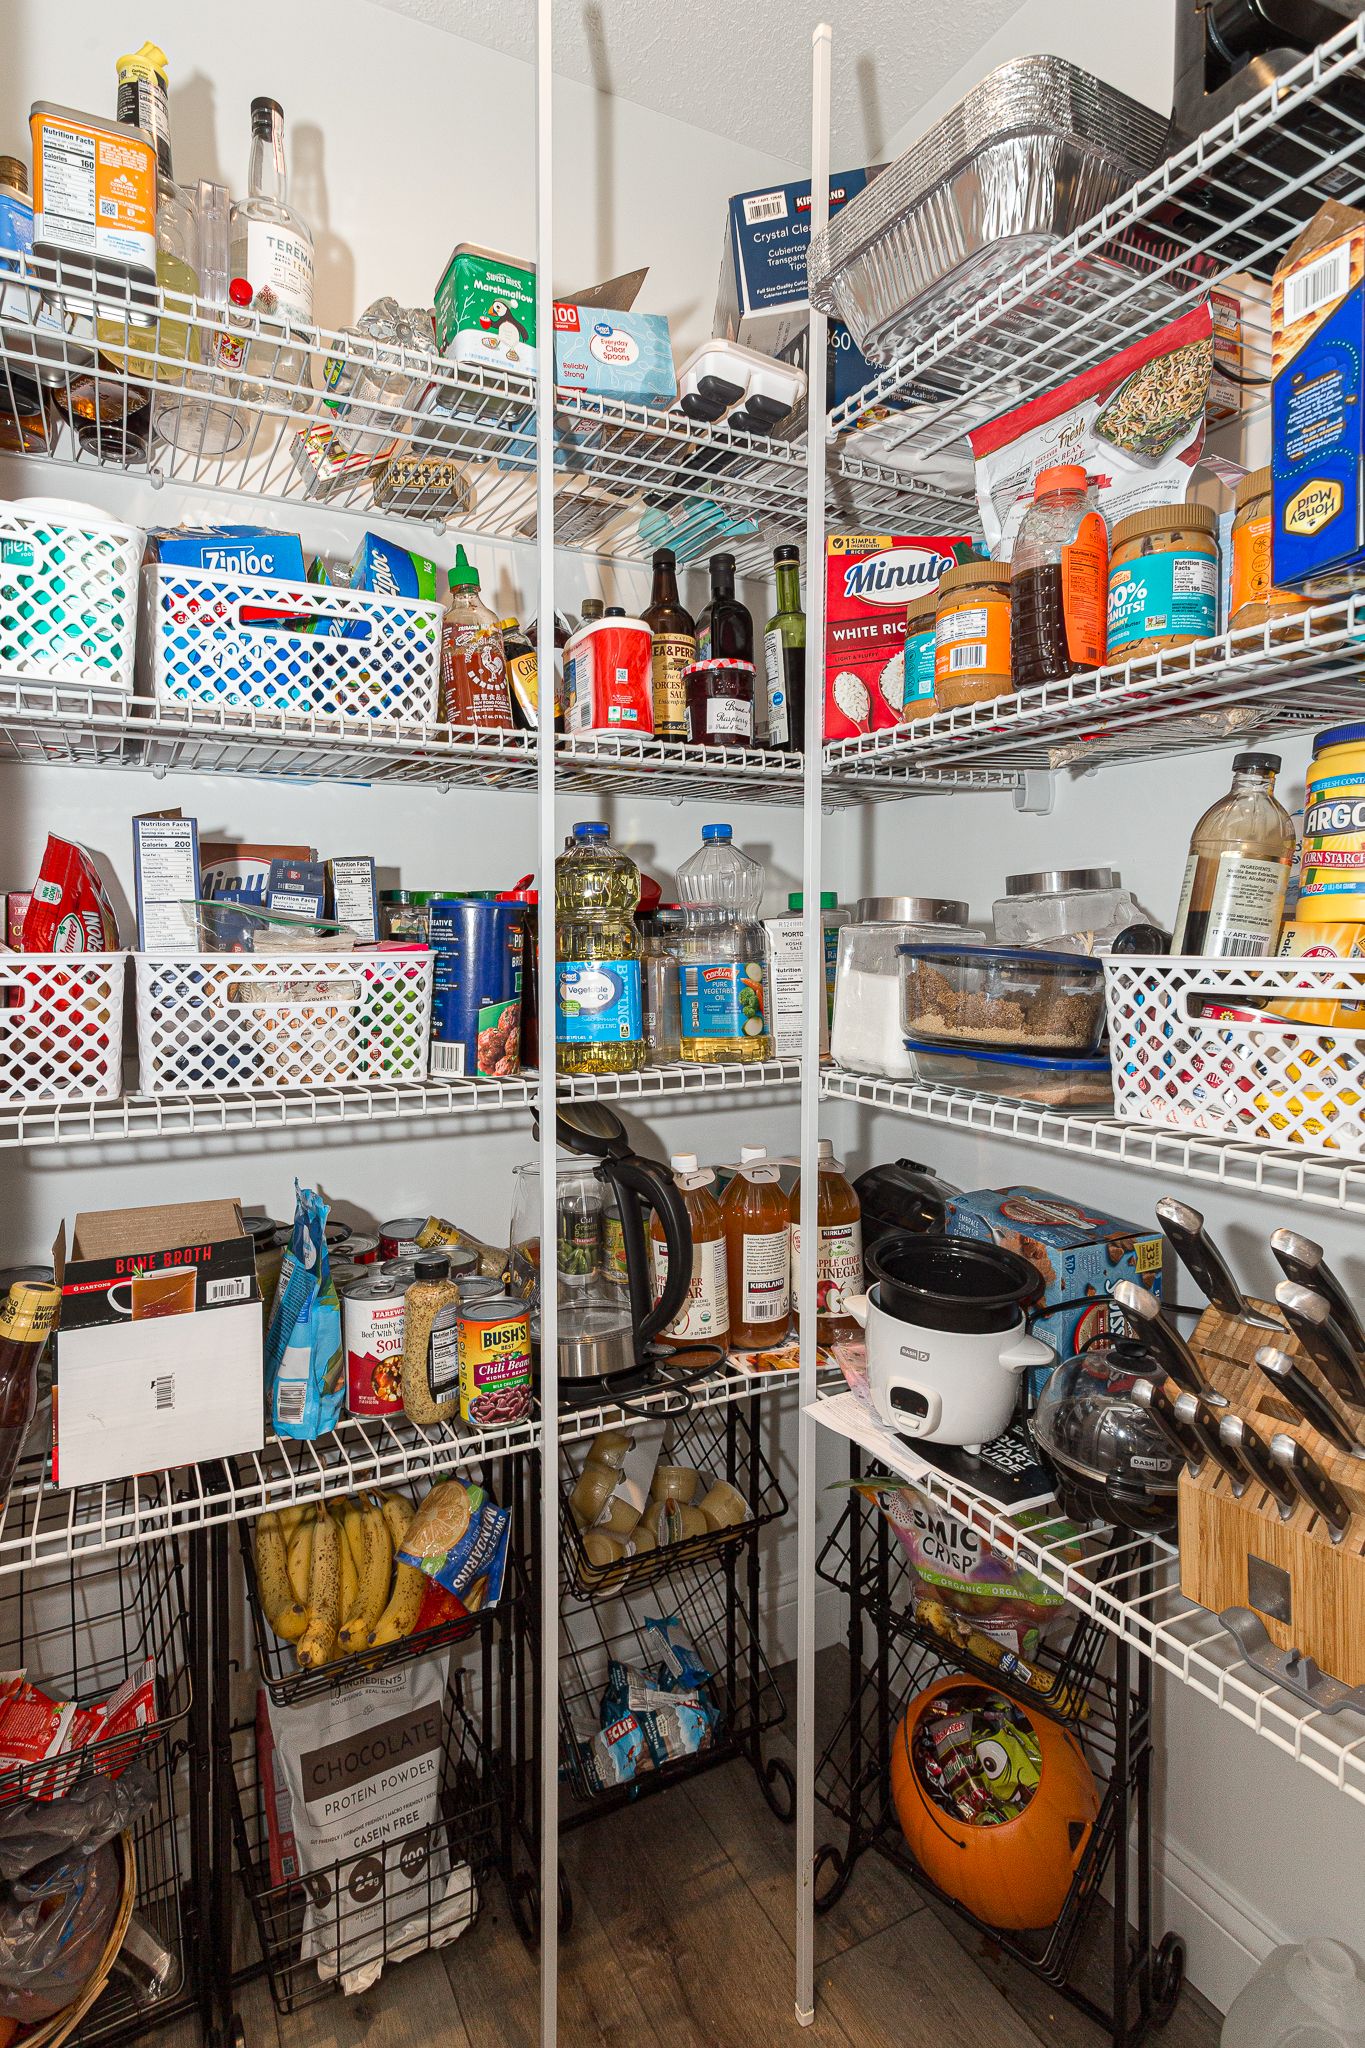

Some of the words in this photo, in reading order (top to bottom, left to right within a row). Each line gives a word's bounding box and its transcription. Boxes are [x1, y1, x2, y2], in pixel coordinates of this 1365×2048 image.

[43, 126, 74, 141] Nutrition
[75, 135, 95, 146] Facts
[43, 151, 68, 163] Calories
[80, 159, 95, 170] 160
[753, 226, 789, 244] Crystal
[791, 223, 812, 236] Clea
[768, 243, 807, 258] Cubiertos
[789, 261, 807, 271] Tipo
[473, 279, 534, 304] Marshmallow
[756, 286, 766, 294] Full
[766, 284, 776, 293] Size
[553, 307, 577, 323] 100
[600, 338, 629, 348] Everyday
[605, 344, 626, 354] Clear
[602, 351, 630, 362] Spoons
[562, 362, 589, 372] Reliably
[564, 371, 585, 380] Strong
[1057, 417, 1086, 449] Fresh
[1033, 456, 1060, 478] GREEN
[1060, 443, 1083, 462] BEAN
[1295, 486, 1332, 512] Maid
[1289, 497, 1335, 526] Honey
[845, 538, 850, 547] 1
[204, 550, 275, 574] Ziploc
[423, 559, 435, 574] 145
[371, 549, 401, 596] Ziploc
[845, 553, 954, 597] Minute
[1107, 578, 1148, 614] 00%
[832, 625, 879, 641] WHITE
[882, 621, 907, 636] RIC
[517, 657, 538, 676] GRA
[716, 711, 749, 728] Raspberry
[1306, 802, 1365, 834] ARGO
[1304, 852, 1324, 864] CORN
[1232, 931, 1248, 939] ART.
[568, 985, 608, 995] Vegetable
[597, 993, 609, 1001] Oil
[958, 1214, 980, 1230] EMBRACE
[115, 1255, 157, 1275] BONE
[163, 1245, 213, 1267] BROTH
[841, 1254, 860, 1267] CIDER
[1145, 1244, 1155, 1267] 33%
[817, 1264, 861, 1279] VINEGAR
[79, 1282, 111, 1291] CARTONS
[750, 1279, 784, 1290] KIRKLAND
[35, 1311, 53, 1321] WIL
[375, 1307, 405, 1318] FAREWA
[370, 1318, 405, 1330] Chunky-St
[361, 1330, 375, 1338] Beef
[376, 1330, 392, 1338] With
[483, 1324, 527, 1349] BUSH'S
[478, 1362, 505, 1376] Chili
[507, 1357, 530, 1371] Beans
[485, 1372, 510, 1381] KIDNEY
[511, 1368, 528, 1376] BEANS
[981, 1447, 1026, 1473] UIDE
[984, 1441, 1038, 1467] TART
[1133, 1459, 1155, 1467] DASH
[452, 1505, 498, 1591] MANDARINS
[922, 1535, 973, 1574] CRISP
[940, 1578, 983, 1594] ORGANIC
[991, 1587, 1033, 1601] ORGANIC
[611, 1717, 634, 1739] CLIF
[312, 1718, 435, 1785] CHOCOLATE
[324, 1783, 377, 1817] PROTEIN
[380, 1759, 435, 1792] POWDER
[353, 1822, 391, 1849] CASEIN
[393, 1809, 420, 1831] FREE
[364, 1813, 386, 1828] FRIENDLY
